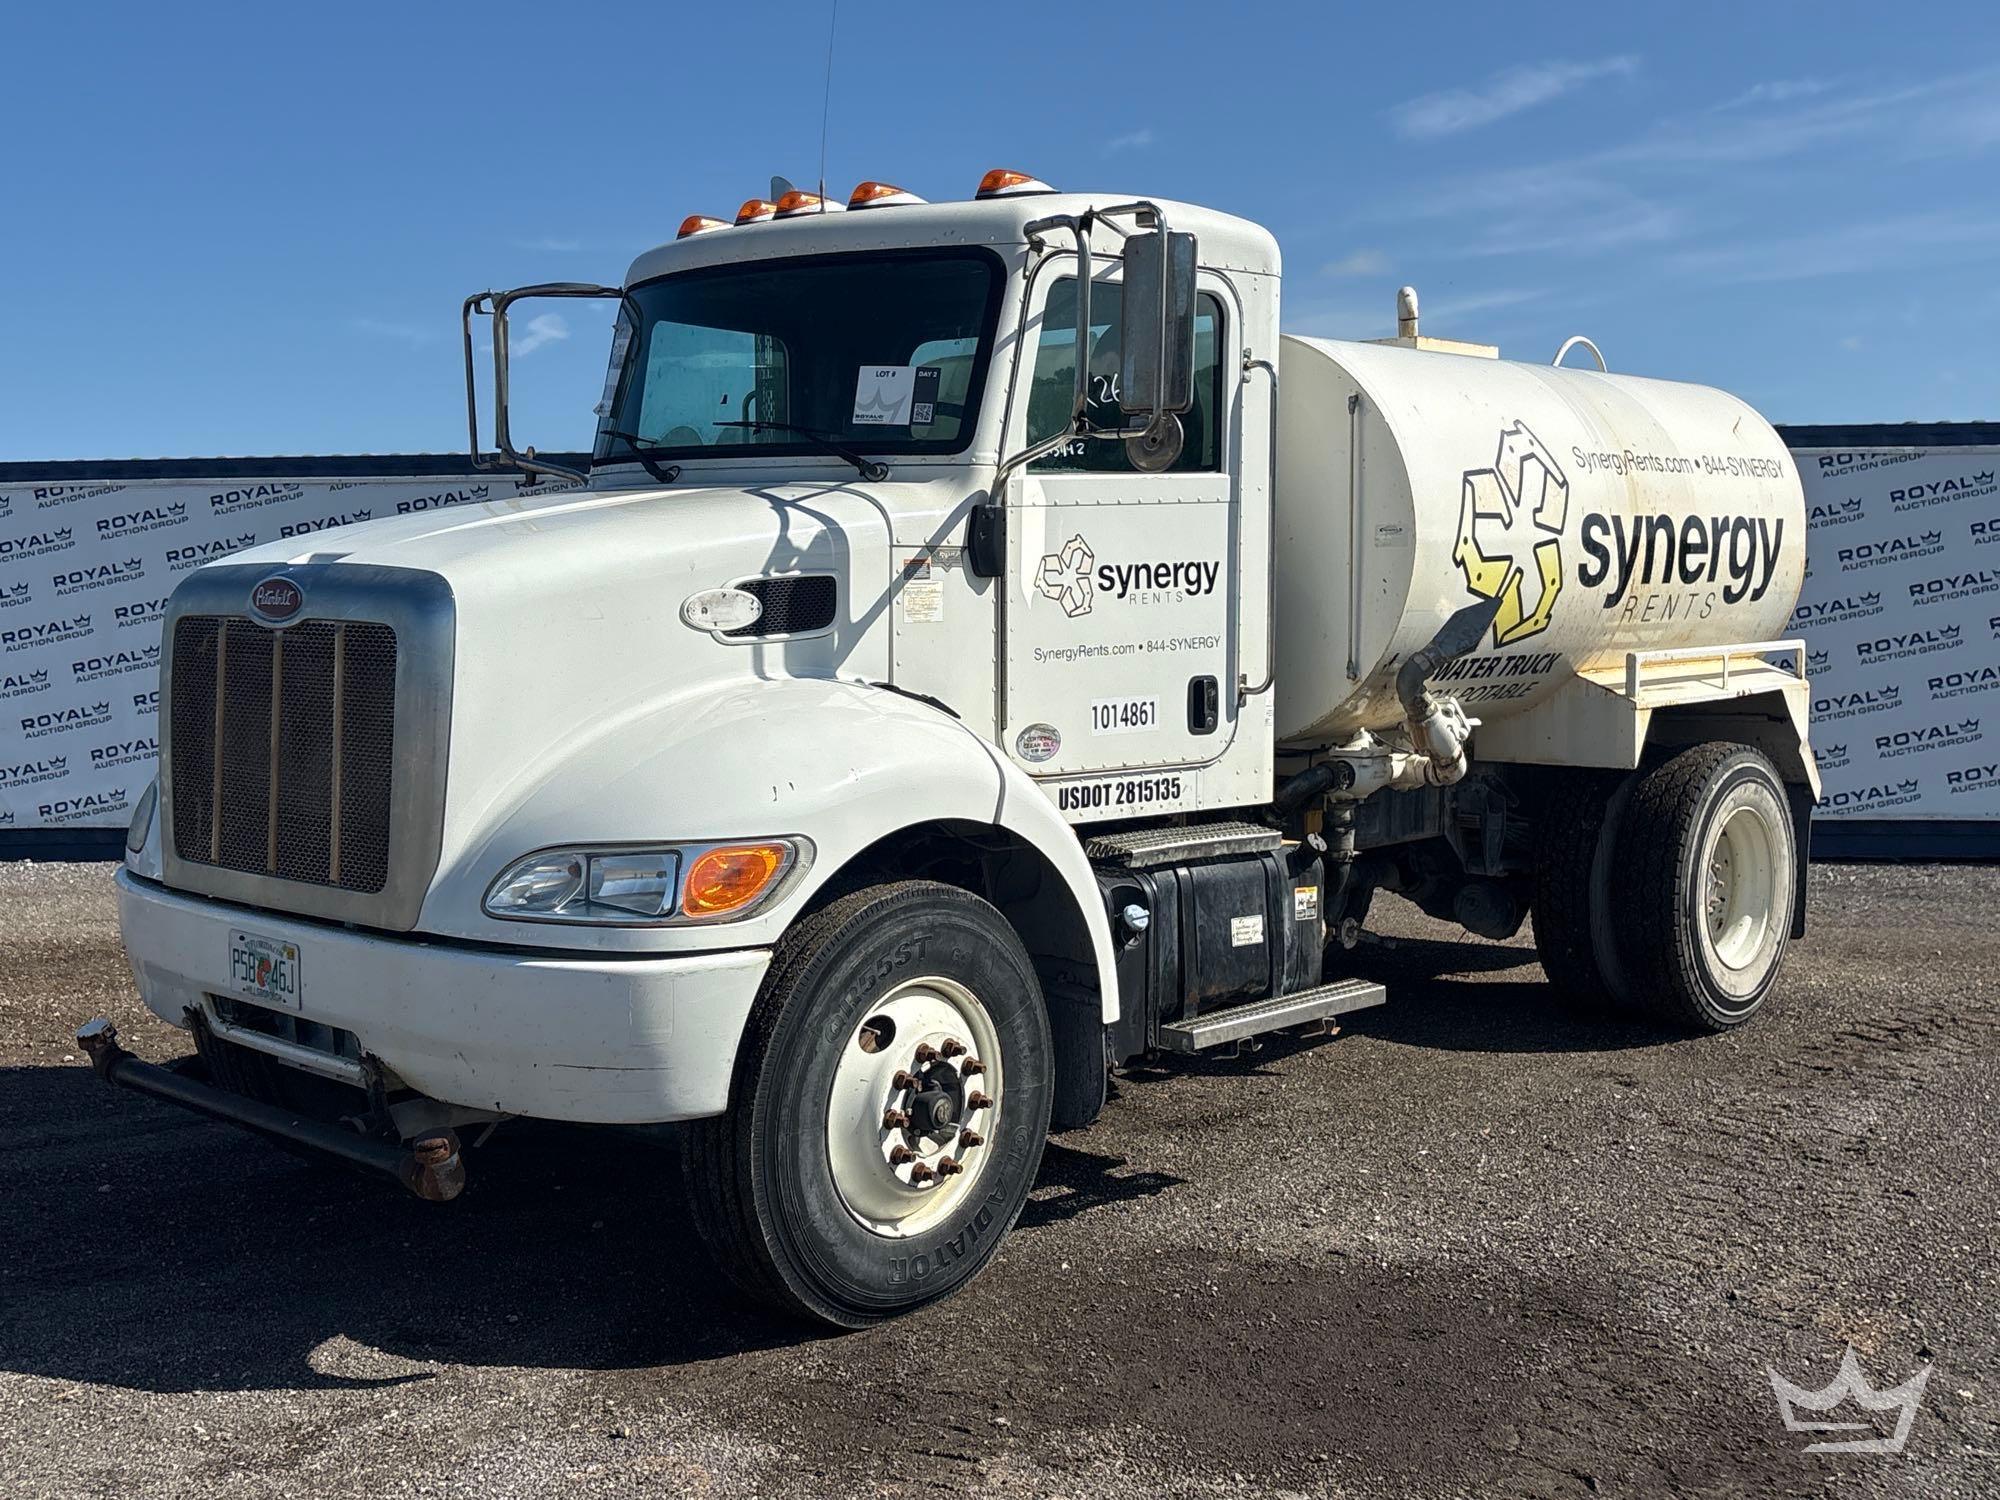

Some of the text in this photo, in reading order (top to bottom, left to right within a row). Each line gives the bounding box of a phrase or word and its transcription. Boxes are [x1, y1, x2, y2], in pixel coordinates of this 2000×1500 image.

[875, 370, 890, 378] LOT
[1572, 445, 1784, 479] SynergyRents.com 844-SYNERGY
[1822, 461, 1879, 479] AUCTION
[38, 493, 87, 510] AUCTION
[210, 484, 282, 507] ROYAL
[397, 490, 471, 514] ROYAL
[1889, 477, 1973, 503] ROYAL
[1894, 485, 1998, 513] AUCTION GROUP
[214, 491, 304, 516] AUCTION GROUP
[96, 508, 168, 532] ROYAL
[101, 516, 189, 541] AUCTION GROUP
[280, 515, 353, 539] ROYAL
[1820, 511, 1865, 528] GROUP
[0, 533, 55, 553] OYAL
[0, 540, 76, 563] CTION GROUP
[166, 539, 238, 562] ROYAL
[1838, 536, 1920, 562] ROYAL
[1577, 512, 1784, 609] synergy
[1841, 545, 1945, 572] AUCTION GROUP
[53, 563, 124, 588] ROYAL
[57, 571, 145, 596] AUCTION GROUP
[1098, 561, 1220, 600] synergy
[1909, 570, 1993, 597] ROYAL
[0, 596, 32, 609] ROUP
[256, 586, 296, 607] Peterbilt
[1129, 590, 1184, 605] RENTS
[1913, 583, 2000, 606] AUCTION GRO
[1621, 592, 1716, 623] RENTS
[1795, 597, 1856, 620] OYAL
[1839, 606, 1884, 622] GROUP
[2, 621, 74, 644] ROYAL
[6, 628, 95, 653] AUCTION GROUP
[1856, 630, 1940, 656] ROYAL
[1034, 635, 1221, 663] SynergyRents.com 844-SYNERGY
[1860, 639, 1964, 666] AUCTION GROUP
[72, 651, 143, 675] ROYAL
[76, 667, 123, 683] AUCTION
[1431, 652, 1563, 682] WATER TRUCK
[1805, 665, 1832, 676] OUP
[12, 683, 51, 697] GROUP
[1928, 666, 2000, 691] ROYA
[1811, 691, 1879, 713] OYAL
[1931, 683, 1988, 701] AUCTION
[21, 707, 93, 731] ROYAL
[1091, 701, 1156, 730] 1014861
[1809, 700, 1903, 724] UCTION GROUP
[25, 715, 113, 740] AUCTION GROUP
[1875, 724, 1958, 750] ROYAL
[90, 738, 159, 762] ROYAL
[1879, 733, 1982, 759] AUCTION GROUP
[94, 754, 142, 770] AUCTION
[1817, 758, 1850, 771] ROUP
[31, 769, 70, 784] GROUP
[1946, 764, 1999, 785] ROY
[39, 794, 109, 817] ROYAL
[1058, 777, 1181, 811] USDOT 2815135
[1816, 784, 1898, 809] ROYAL
[1877, 793, 1922, 808] GROUP
[92, 802, 129, 816] GROUP
